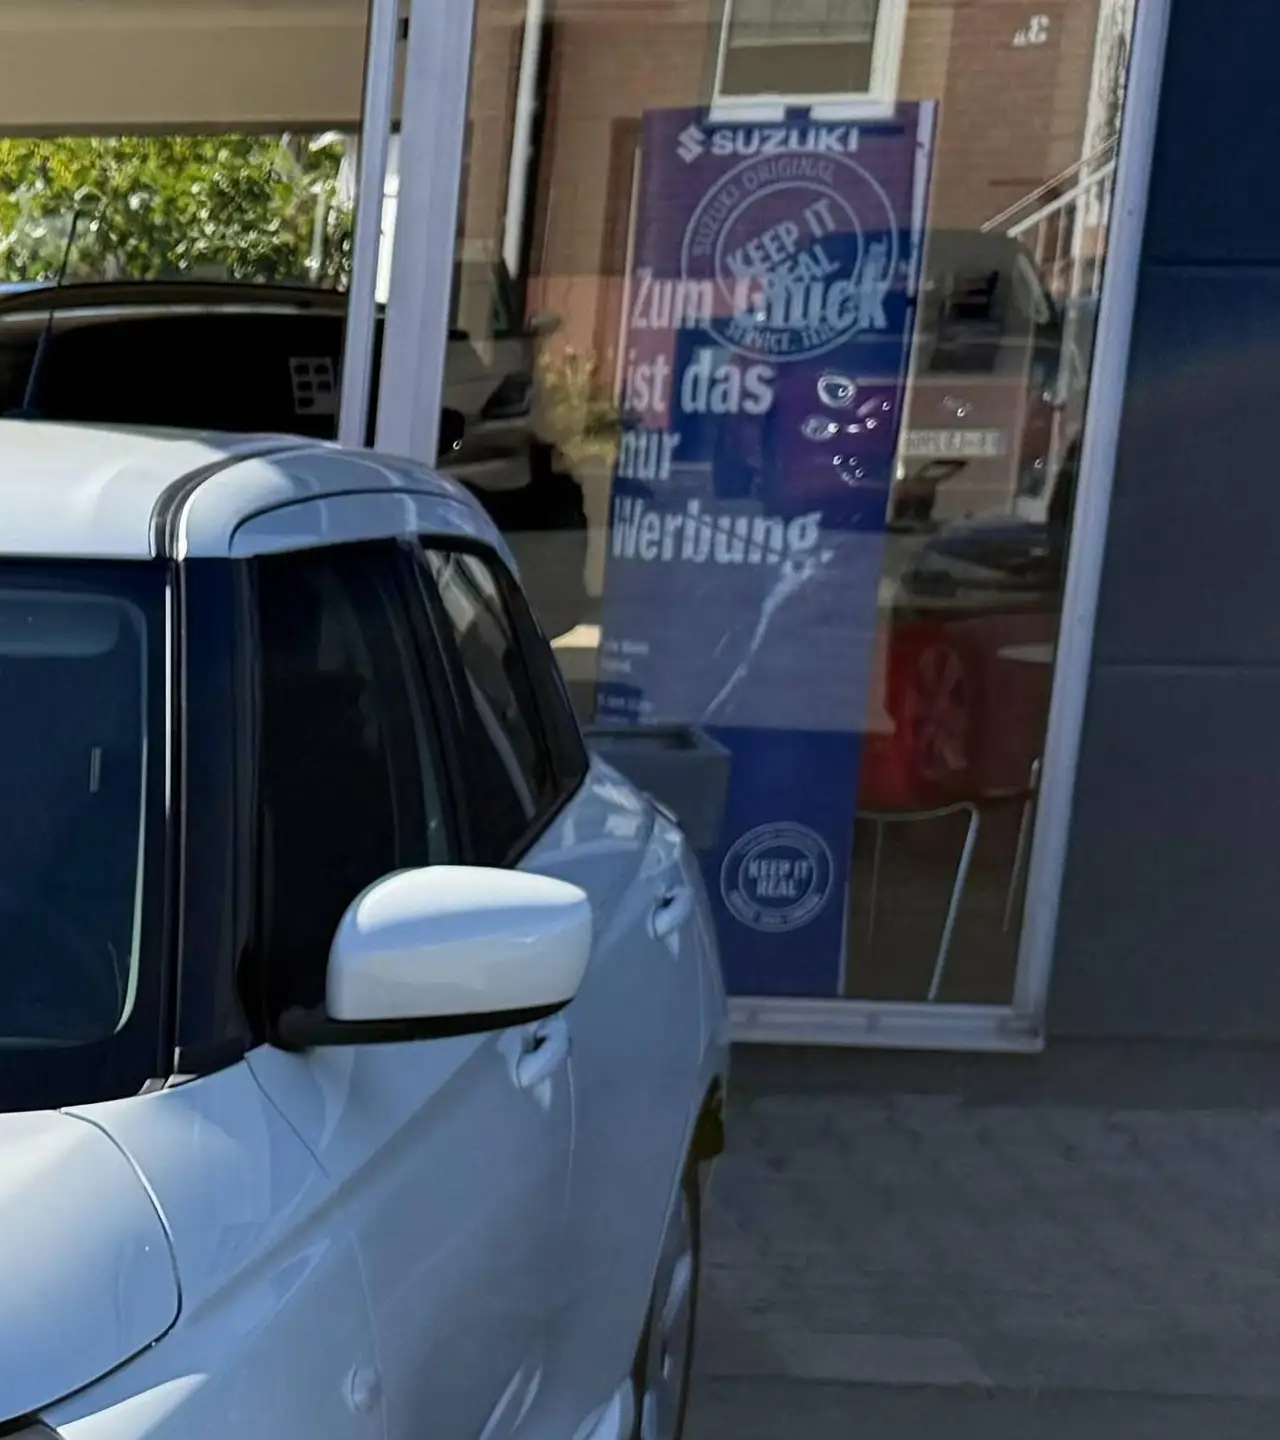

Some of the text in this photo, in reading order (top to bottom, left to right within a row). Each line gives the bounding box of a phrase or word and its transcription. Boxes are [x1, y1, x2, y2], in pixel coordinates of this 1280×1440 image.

[711, 125, 860, 156] SUZUKI
[742, 156, 836, 190] ORIGINAL
[725, 197, 837, 279] KEEP IT
[630, 266, 713, 330] Zum
[624, 347, 776, 416] ist das
[617, 430, 681, 481] nur
[611, 497, 835, 581] Werbung.
